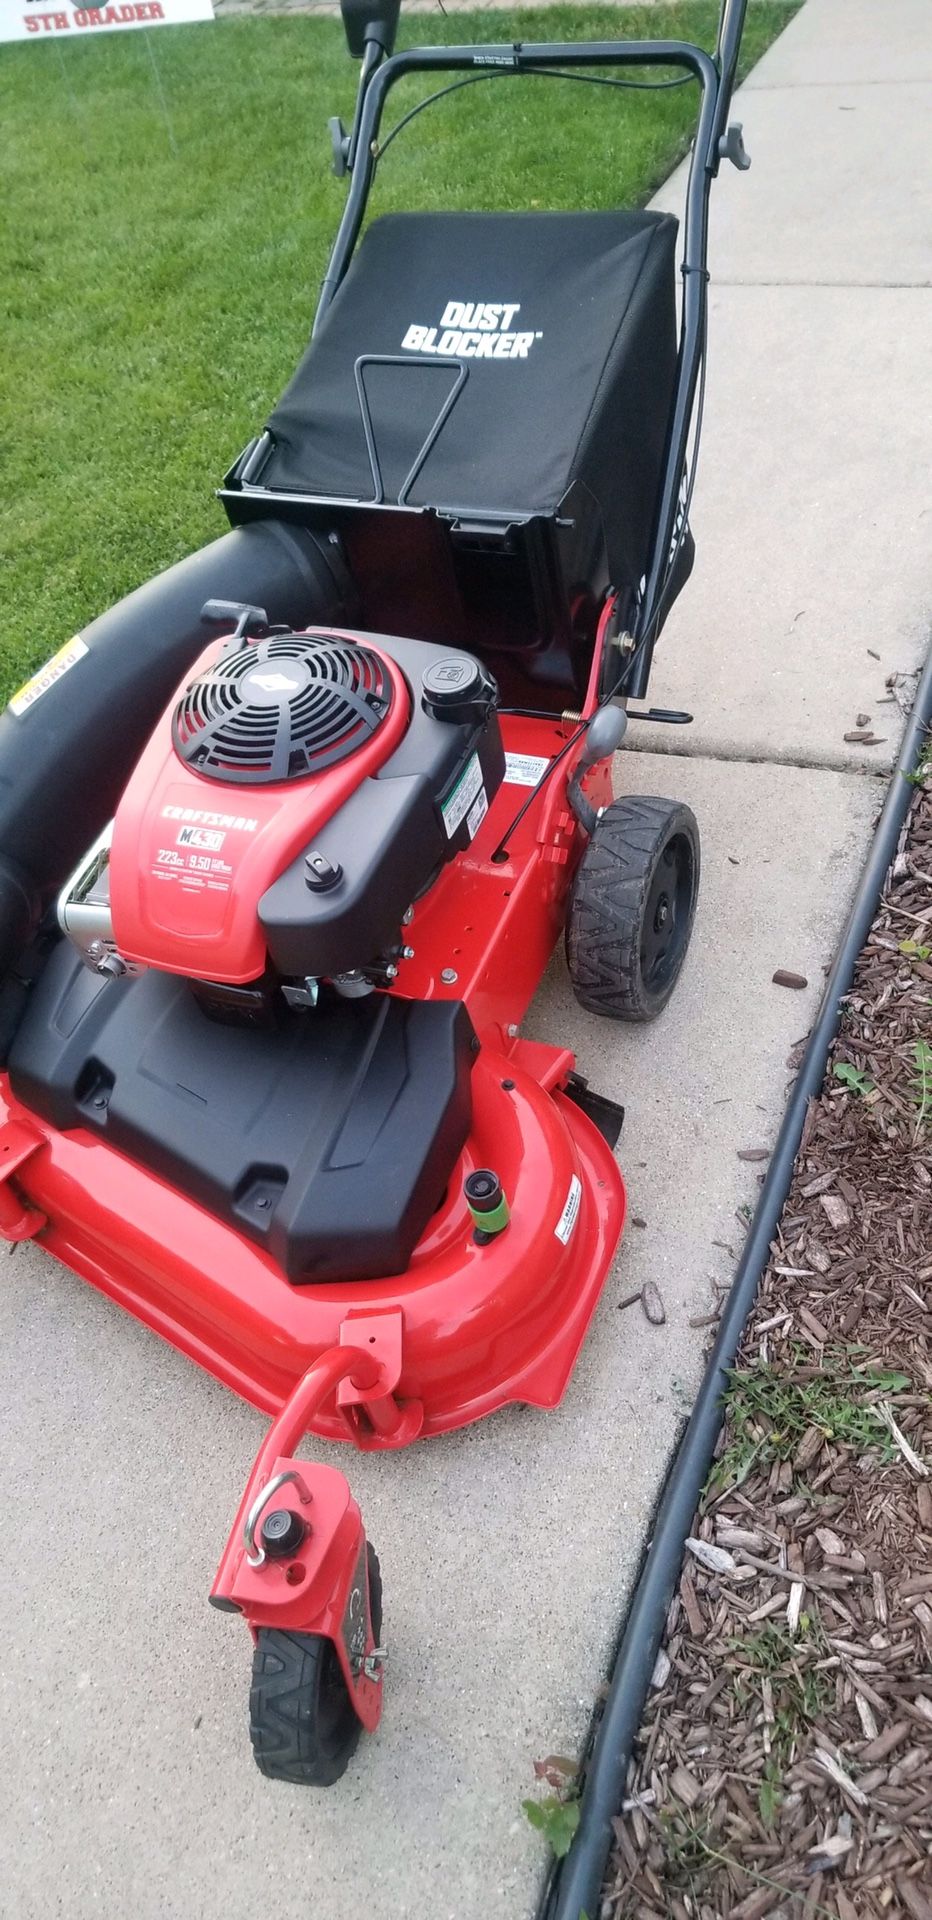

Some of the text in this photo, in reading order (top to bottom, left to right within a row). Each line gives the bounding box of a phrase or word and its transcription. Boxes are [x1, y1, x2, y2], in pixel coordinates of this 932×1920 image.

[23, 1, 165, 32] 5TH GRADER
[440, 301, 520, 330] DUST
[401, 324, 535, 358] BLOCKER
[24, 653, 76, 703] DANGER
[161, 805, 259, 832] CRAFTSMAN
[189, 854, 212, 871] 9.50
